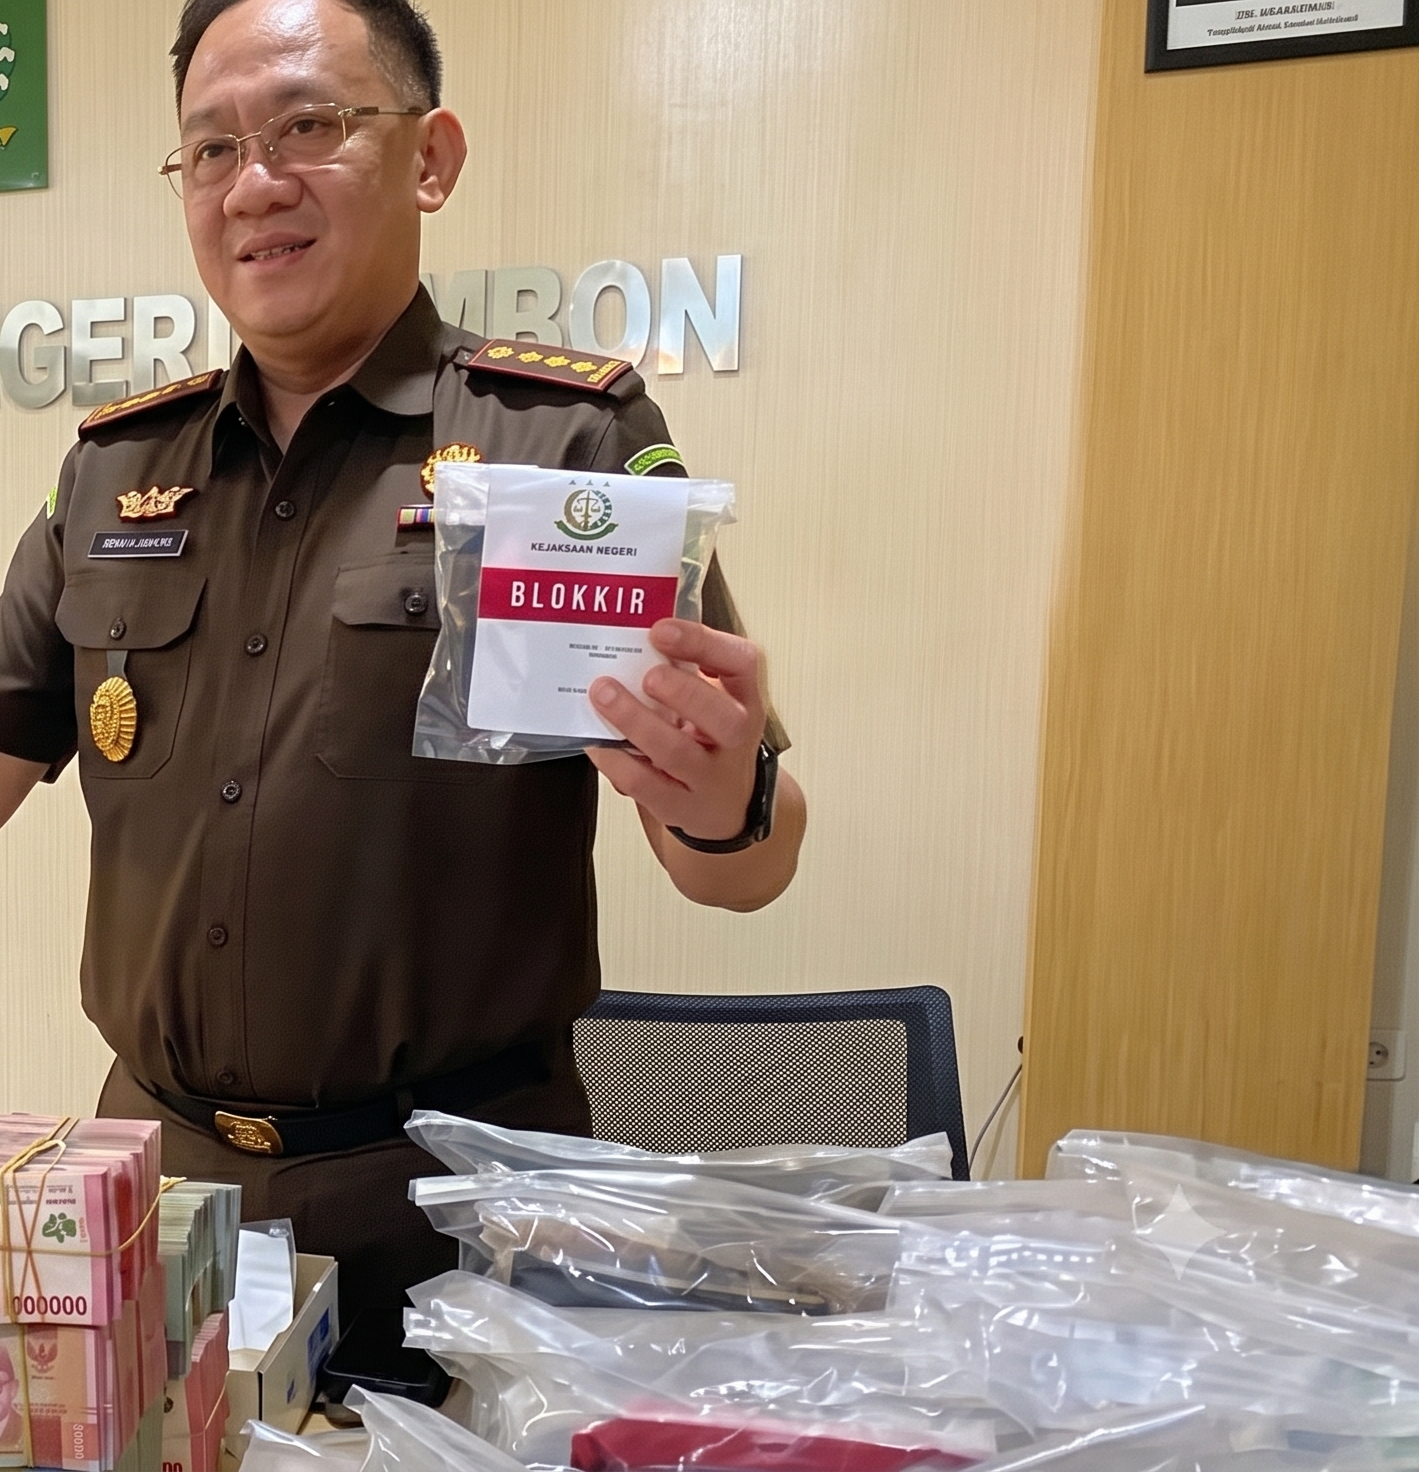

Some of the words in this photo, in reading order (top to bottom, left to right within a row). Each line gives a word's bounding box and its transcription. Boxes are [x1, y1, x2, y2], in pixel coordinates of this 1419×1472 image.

[419, 254, 742, 375] MBON
[530, 542, 594, 554] KEJAKSAAN
[596, 546, 637, 557] NEGERI
[510, 581, 646, 615] BLOKKIR
